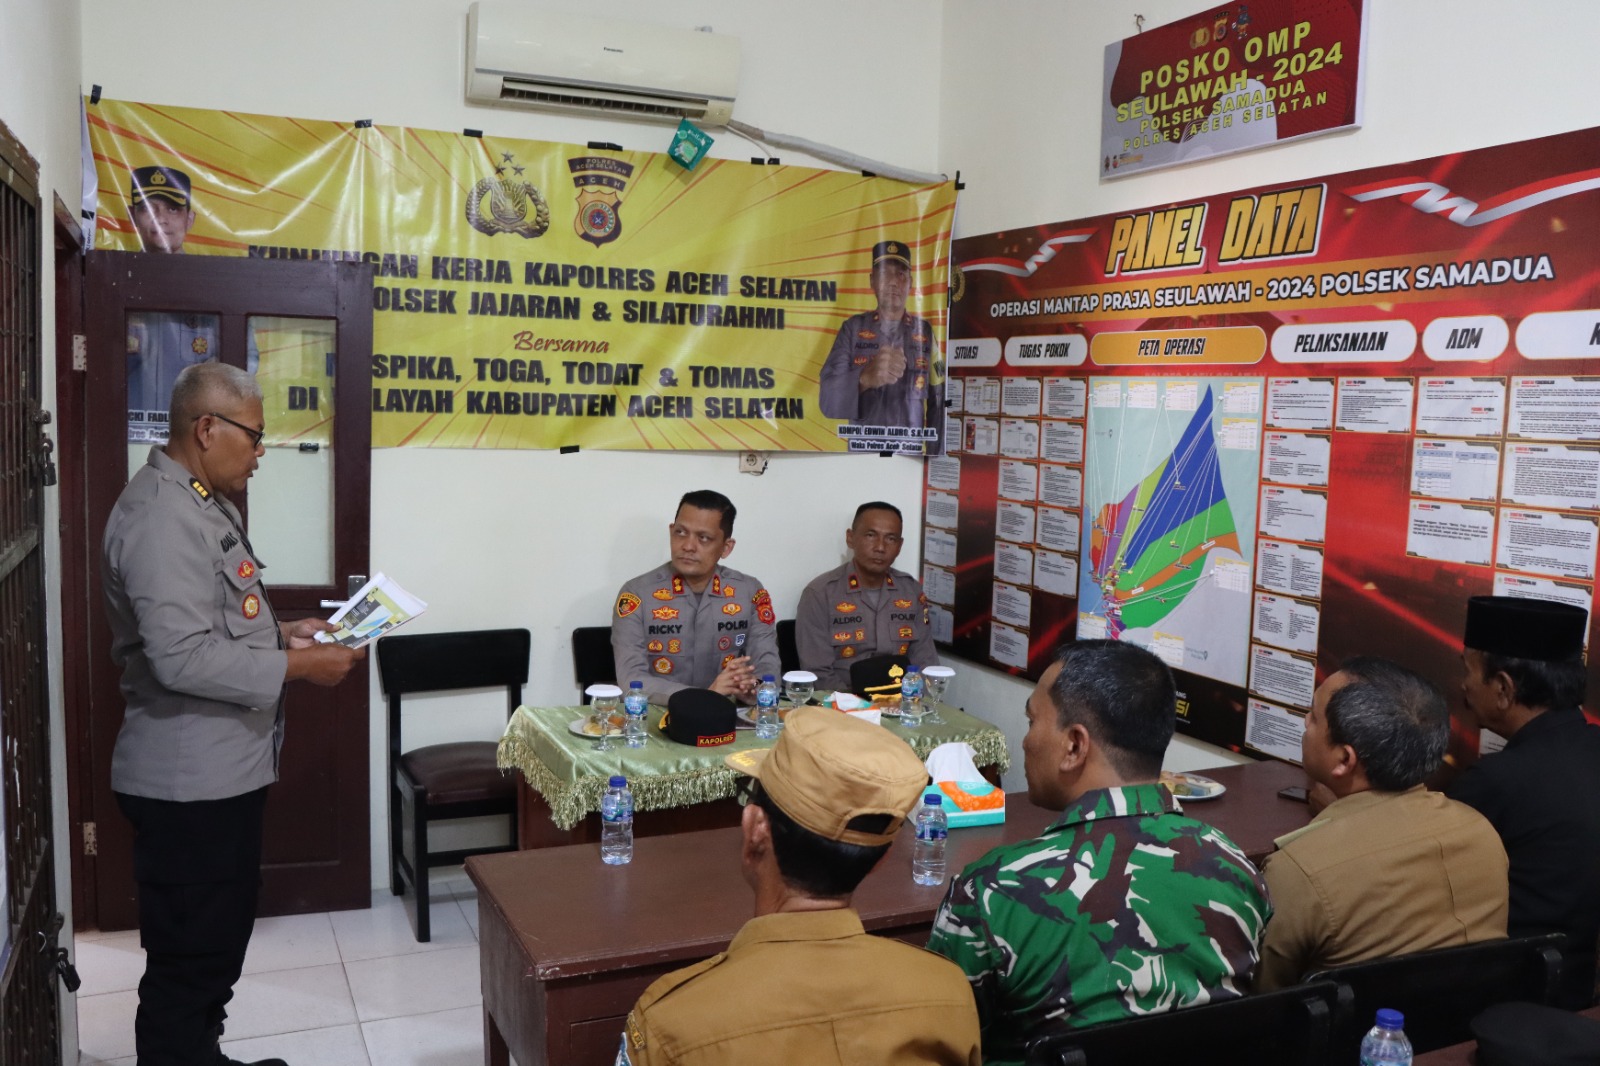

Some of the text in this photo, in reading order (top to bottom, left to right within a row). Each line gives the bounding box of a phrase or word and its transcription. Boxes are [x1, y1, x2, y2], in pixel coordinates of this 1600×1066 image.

[1140, 21, 1311, 93] POSKO OMP
[1116, 41, 1343, 123] SEULAWAH - 2024
[1140, 80, 1306, 133] POLSEK SAMADUA
[1124, 91, 1328, 151] POLRES ACEH SELATAN
[586, 158, 616, 166] POLRES
[596, 163, 627, 174] SELATAN
[578, 177, 621, 188] ACEH
[1104, 183, 1326, 276] PANEL DATA
[432, 256, 513, 284] KERJA
[525, 261, 655, 292] KAPOLRES
[665, 271, 728, 296] ACEH
[740, 275, 837, 302] SELATAN
[990, 255, 1554, 318] OPERASI MANTAP PRAJA SEULAWAH - 2024 POLSEK SAMADUA
[373, 286, 784, 330] OLSEK JAJARAN & SILATURAHMI
[513, 330, 609, 354] Bersama
[1138, 337, 1206, 356] PETA OPERASI
[1294, 331, 1389, 353] PELAKSANAAN
[1445, 327, 1484, 349] ADM
[954, 345, 979, 360] SITUASI
[1018, 342, 1070, 358] TUGAS POKOK
[371, 354, 775, 389] SPIKA, TOGA, TODAT & TOMAS
[288, 385, 804, 419] DI LAYAH KABUPATEN ACEH SELATAN
[838, 425, 862, 435] KOMPOL
[864, 426, 885, 436] EDWIN
[648, 624, 682, 635] RICKY
[718, 620, 748, 632] POLRI
[832, 615, 863, 625] ALDRO
[699, 734, 734, 745] KAPOLRES
